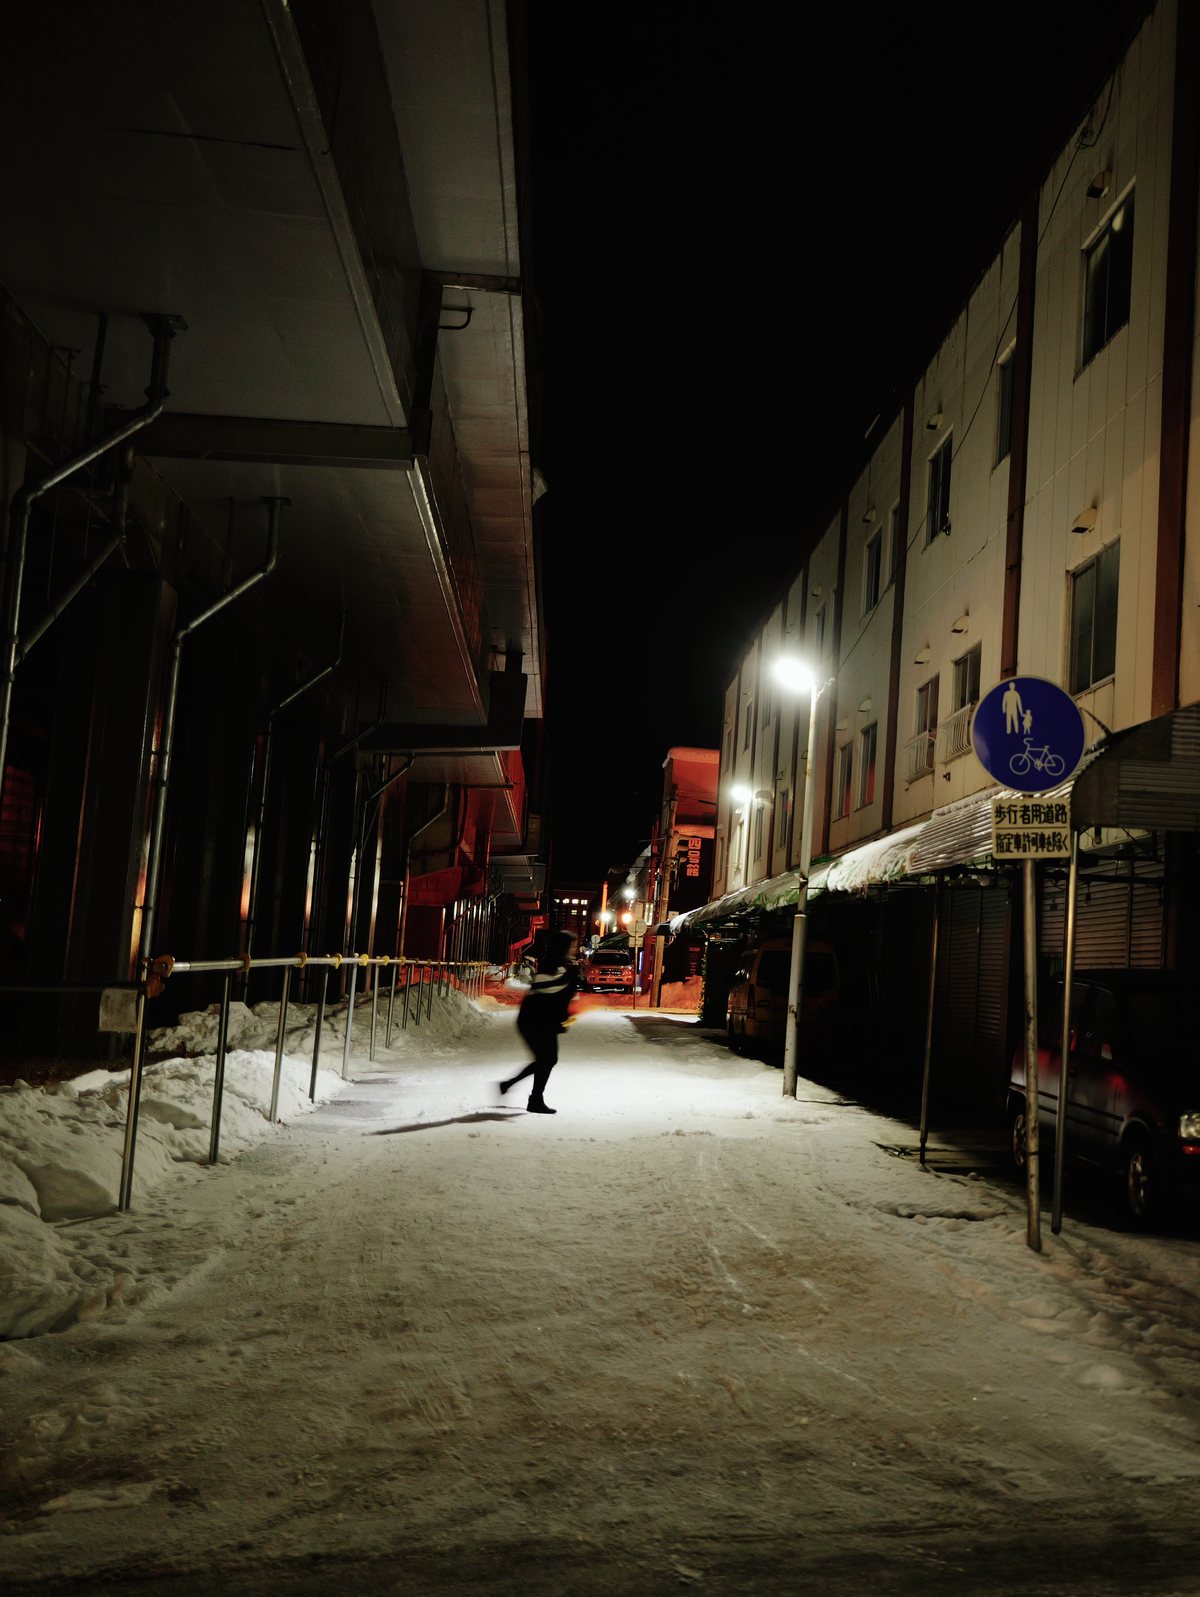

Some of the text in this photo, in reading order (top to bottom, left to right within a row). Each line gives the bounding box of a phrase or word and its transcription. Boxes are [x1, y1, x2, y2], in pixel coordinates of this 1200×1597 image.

[995, 803, 1067, 825] 歩行者用道路
[996, 832, 1068, 854] 指定車許可車を除く
